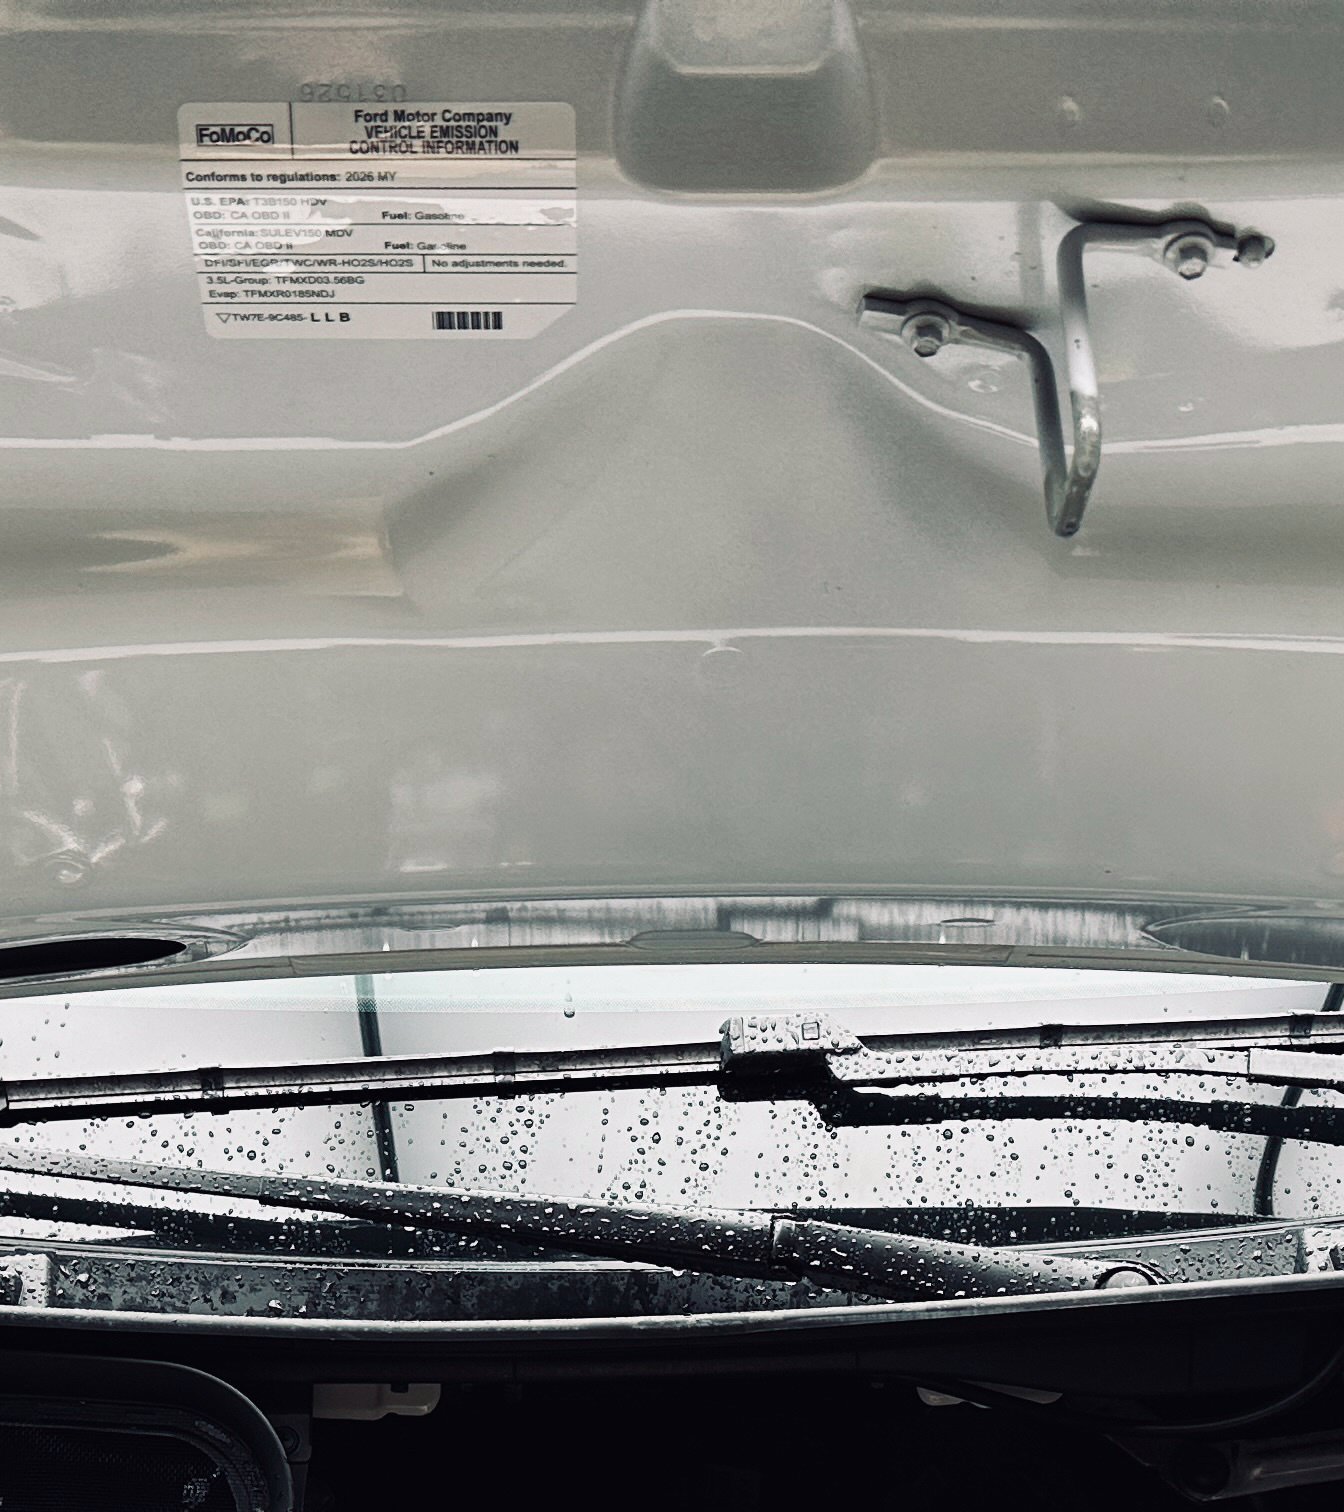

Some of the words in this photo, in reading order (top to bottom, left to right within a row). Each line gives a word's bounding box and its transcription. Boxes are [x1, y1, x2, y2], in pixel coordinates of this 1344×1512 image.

[354, 110, 388, 122] Ford
[394, 110, 436, 122] Motor
[442, 110, 512, 125] Company
[199, 127, 271, 143] FoMoCo
[365, 125, 425, 138] VEHICLE
[431, 125, 498, 138] EMISSION
[350, 140, 417, 154] CONTROL
[422, 140, 518, 154] INFORMATION
[186, 172, 246, 182] Conforms
[251, 173, 263, 181] to
[267, 172, 341, 184] regulations:
[346, 172, 373, 181] 2026
[378, 172, 396, 182] MY
[191, 198, 216, 206] U.S.
[220, 198, 250, 206] EPA:
[194, 211, 225, 219] OBD:
[230, 211, 247, 219] CA
[252, 211, 279, 219] OBD
[382, 212, 411, 220] Fuel:
[415, 212, 464, 220] Gasoline
[261, 229, 322, 237] SULEV150
[452, 260, 519, 268] adjustments
[311, 313, 320, 322] L
[326, 313, 334, 322] L
[340, 313, 350, 322] B
